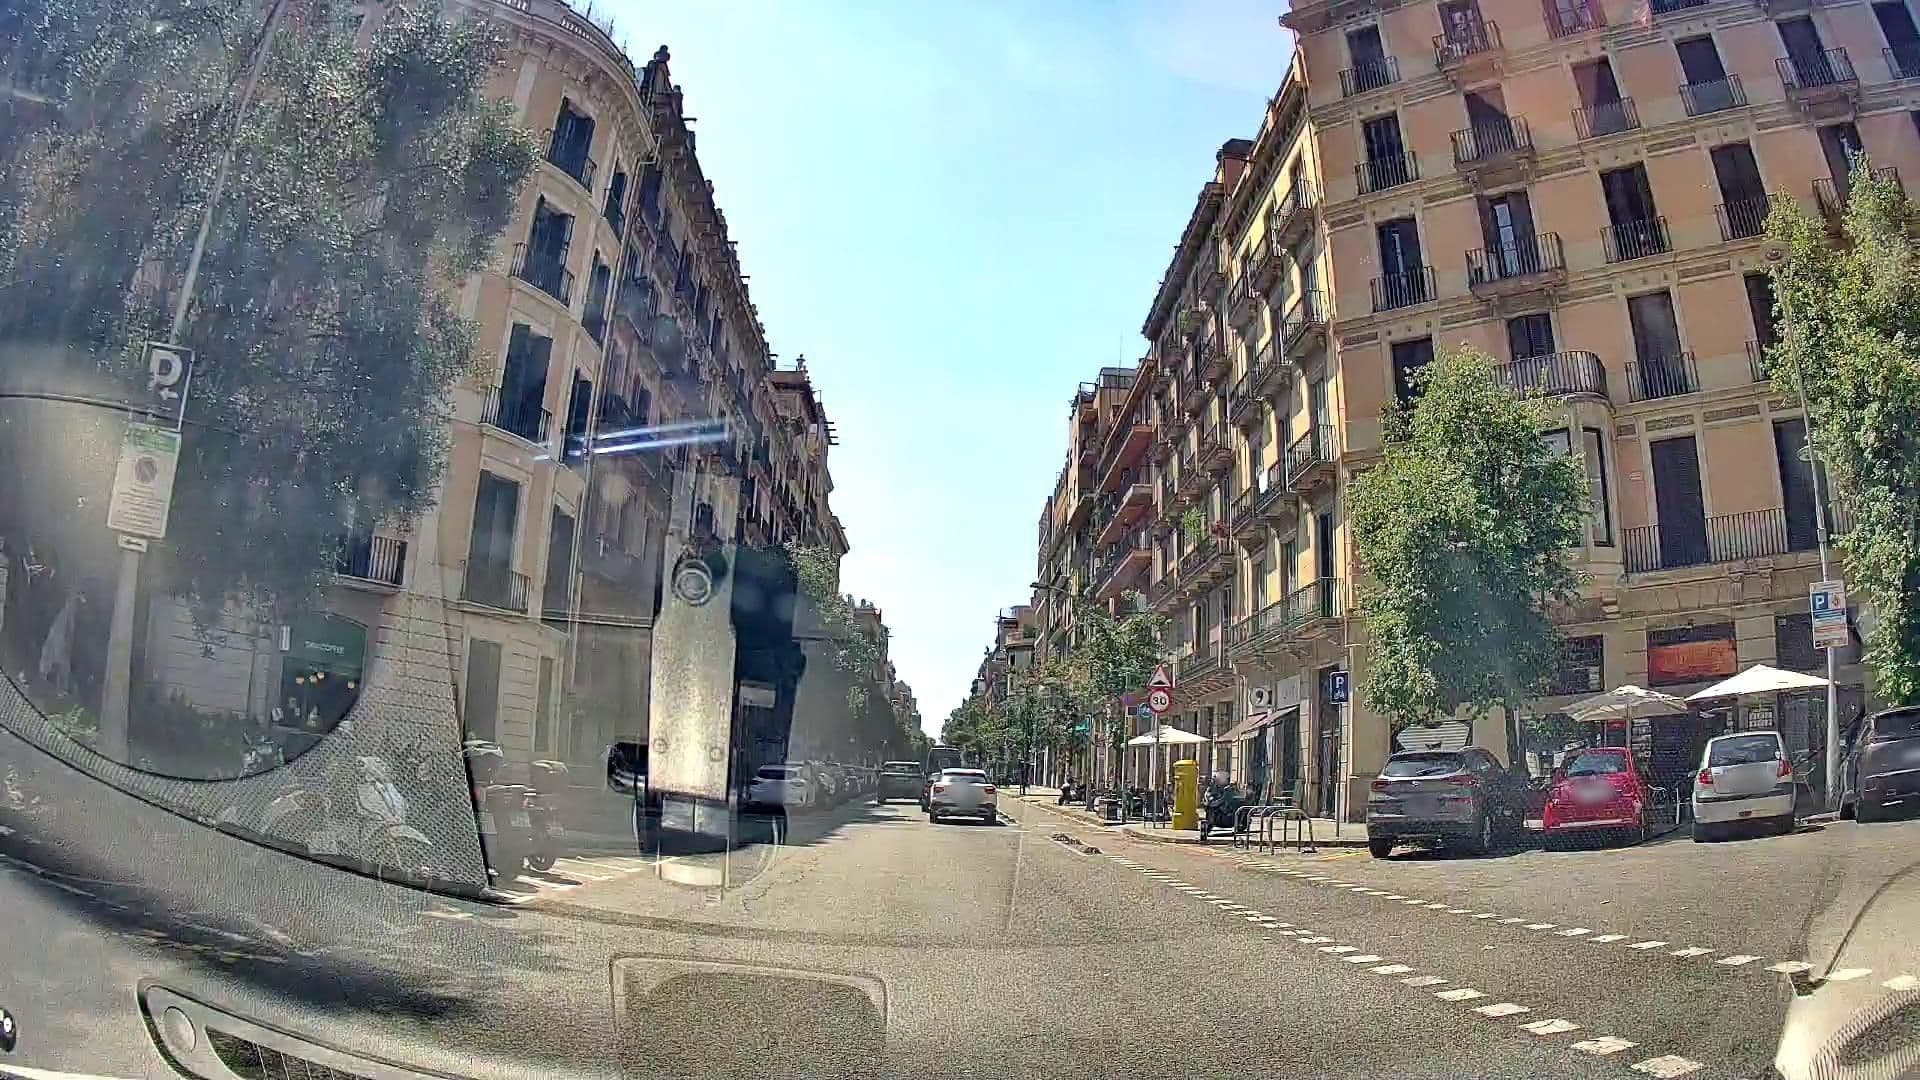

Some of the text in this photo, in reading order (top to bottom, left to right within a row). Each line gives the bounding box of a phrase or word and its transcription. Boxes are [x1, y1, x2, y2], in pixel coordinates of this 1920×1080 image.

[150, 349, 182, 389] P
[1815, 594, 1825, 609] P
[1335, 676, 1345, 688] P
[1152, 696, 1167, 705] 30
